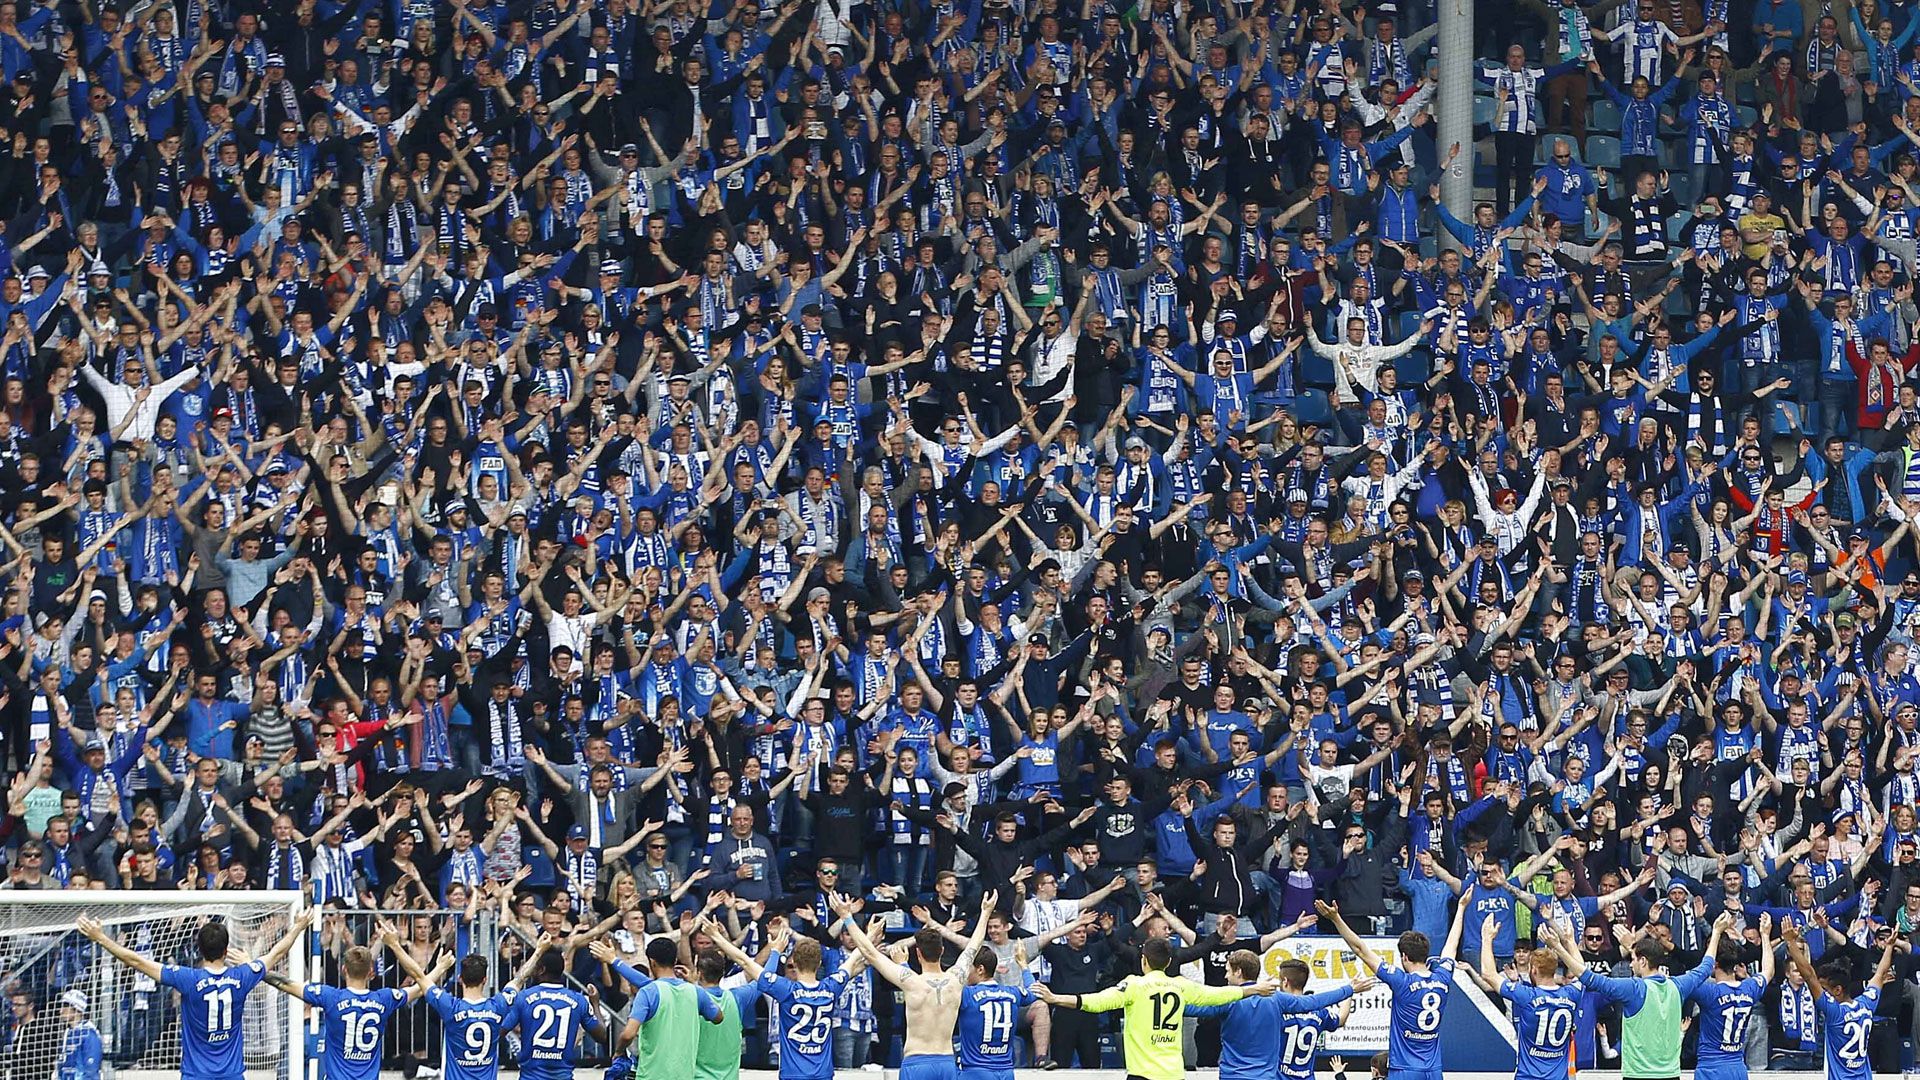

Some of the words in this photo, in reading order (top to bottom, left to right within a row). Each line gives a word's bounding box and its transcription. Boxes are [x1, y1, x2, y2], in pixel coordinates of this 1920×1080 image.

[481, 458, 504, 469] FAM
[1477, 898, 1509, 911] D-K-H
[203, 988, 232, 1032] 11
[532, 1004, 571, 1049] 21
[787, 1003, 833, 1045] 25
[979, 1001, 1012, 1042] 14
[1149, 991, 1181, 1031] 12
[1416, 992, 1441, 1032] 8
[1534, 1007, 1573, 1047] 10
[1721, 1005, 1752, 1043] 17
[208, 1032, 230, 1043] Beck
[342, 1012, 381, 1052] 16
[464, 1021, 492, 1061] 9
[1283, 1024, 1318, 1065] 19
[1839, 1019, 1873, 1060] 20
